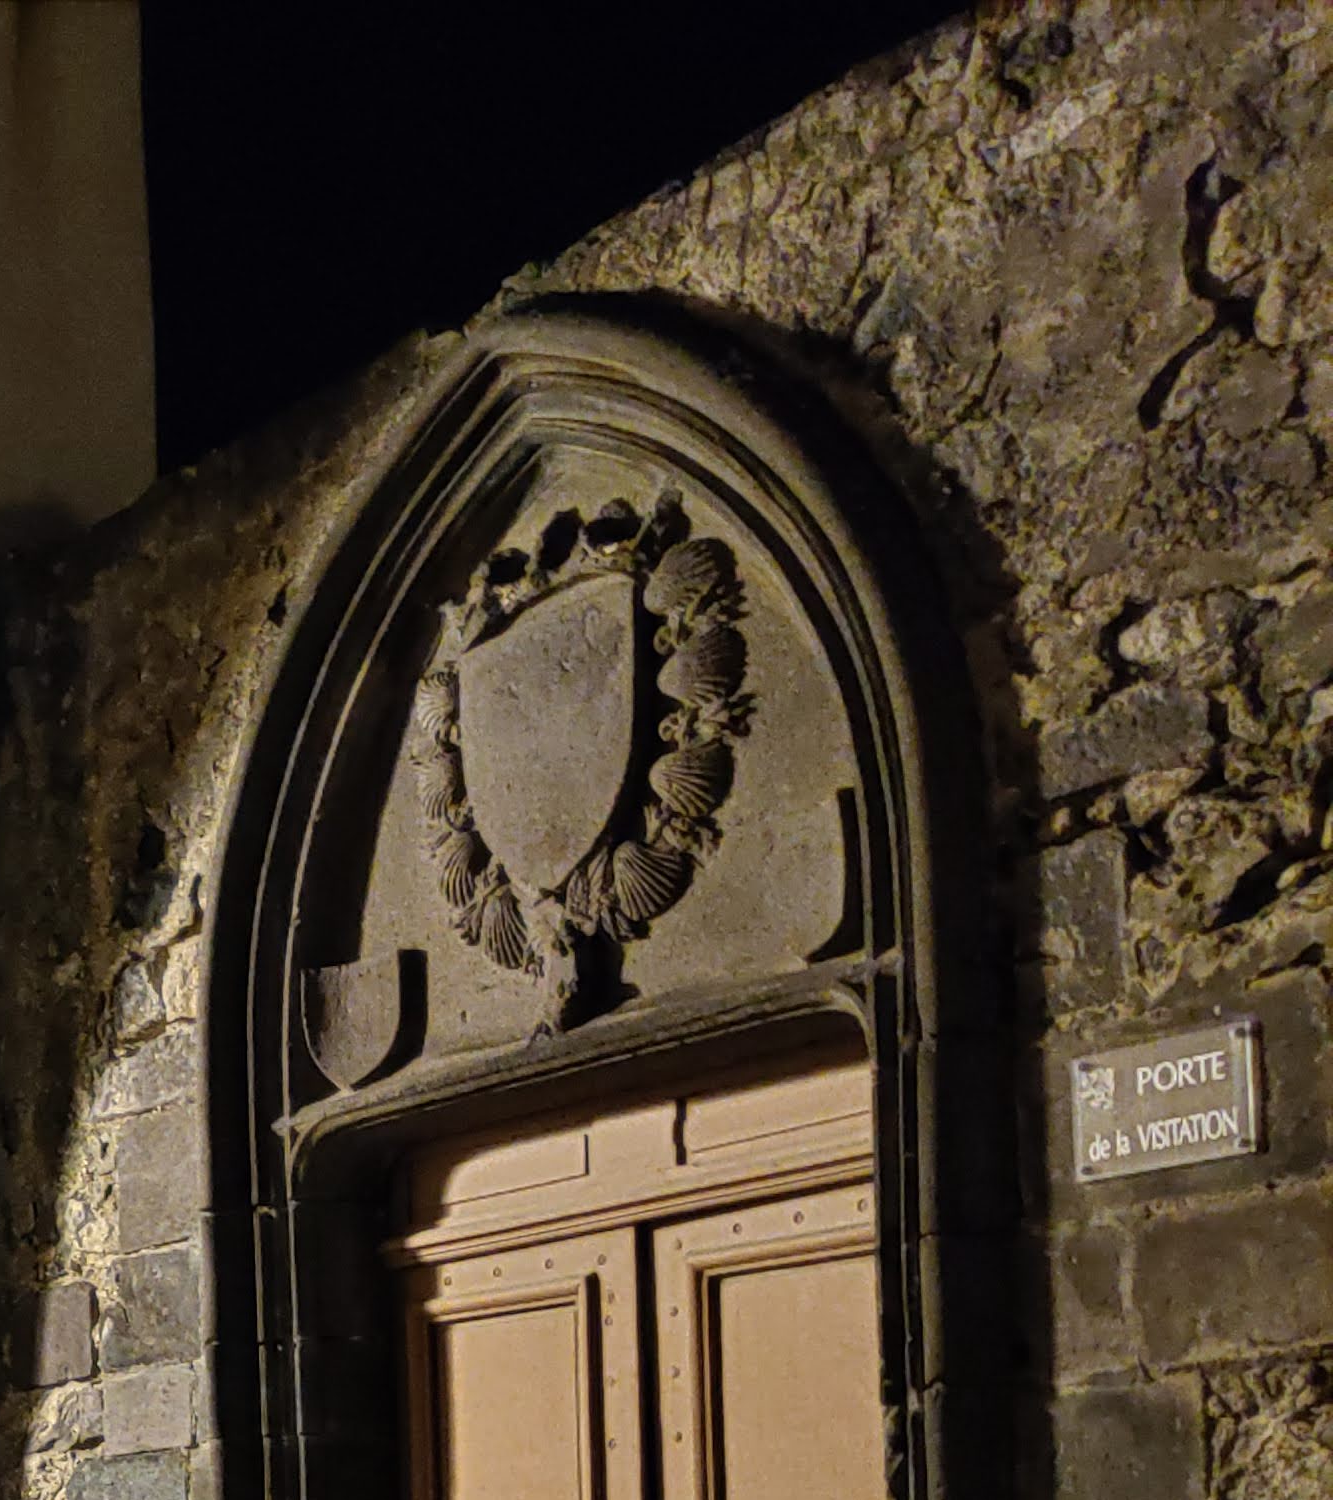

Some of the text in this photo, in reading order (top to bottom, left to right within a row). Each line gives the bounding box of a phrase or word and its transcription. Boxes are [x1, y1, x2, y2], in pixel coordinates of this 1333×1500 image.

[1136, 1051, 1226, 1096] PORTE
[1089, 1106, 1238, 1162] de la VISITATION
